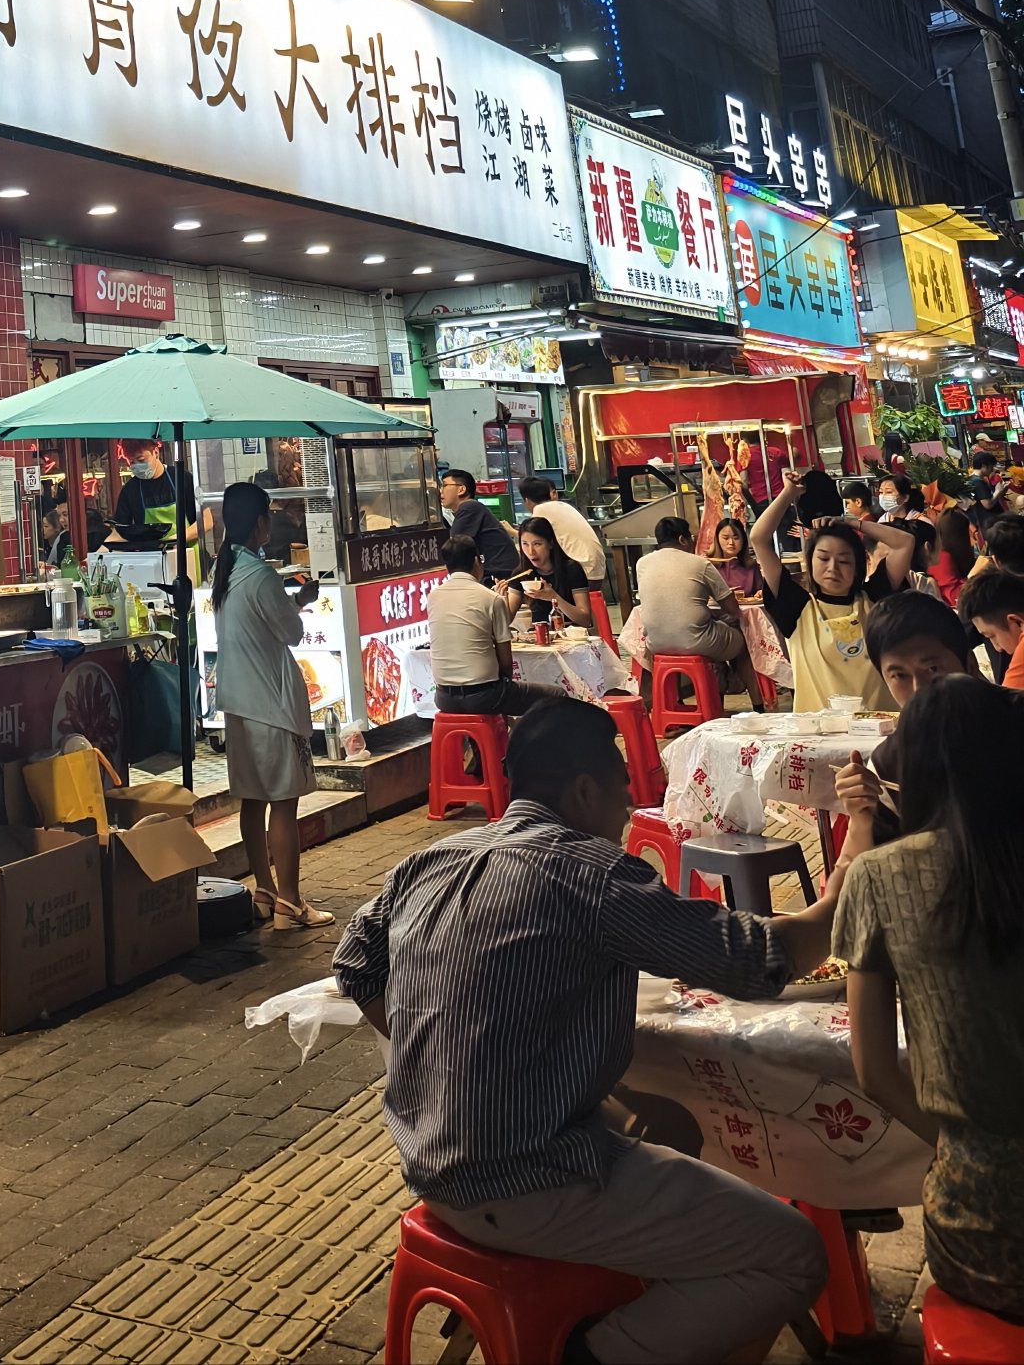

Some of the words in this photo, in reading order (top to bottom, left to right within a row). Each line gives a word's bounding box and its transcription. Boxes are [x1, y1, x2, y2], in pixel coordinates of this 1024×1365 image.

[475, 89, 513, 146] 烧烤
[521, 108, 552, 159] 卤味
[482, 144, 560, 208] 江湖菜
[586, 155, 643, 254] 新疆
[677, 187, 719, 274] 餐厅
[96, 269, 144, 311] Super
[143, 280, 166, 298] chuan
[142, 297, 166, 311] chuan
